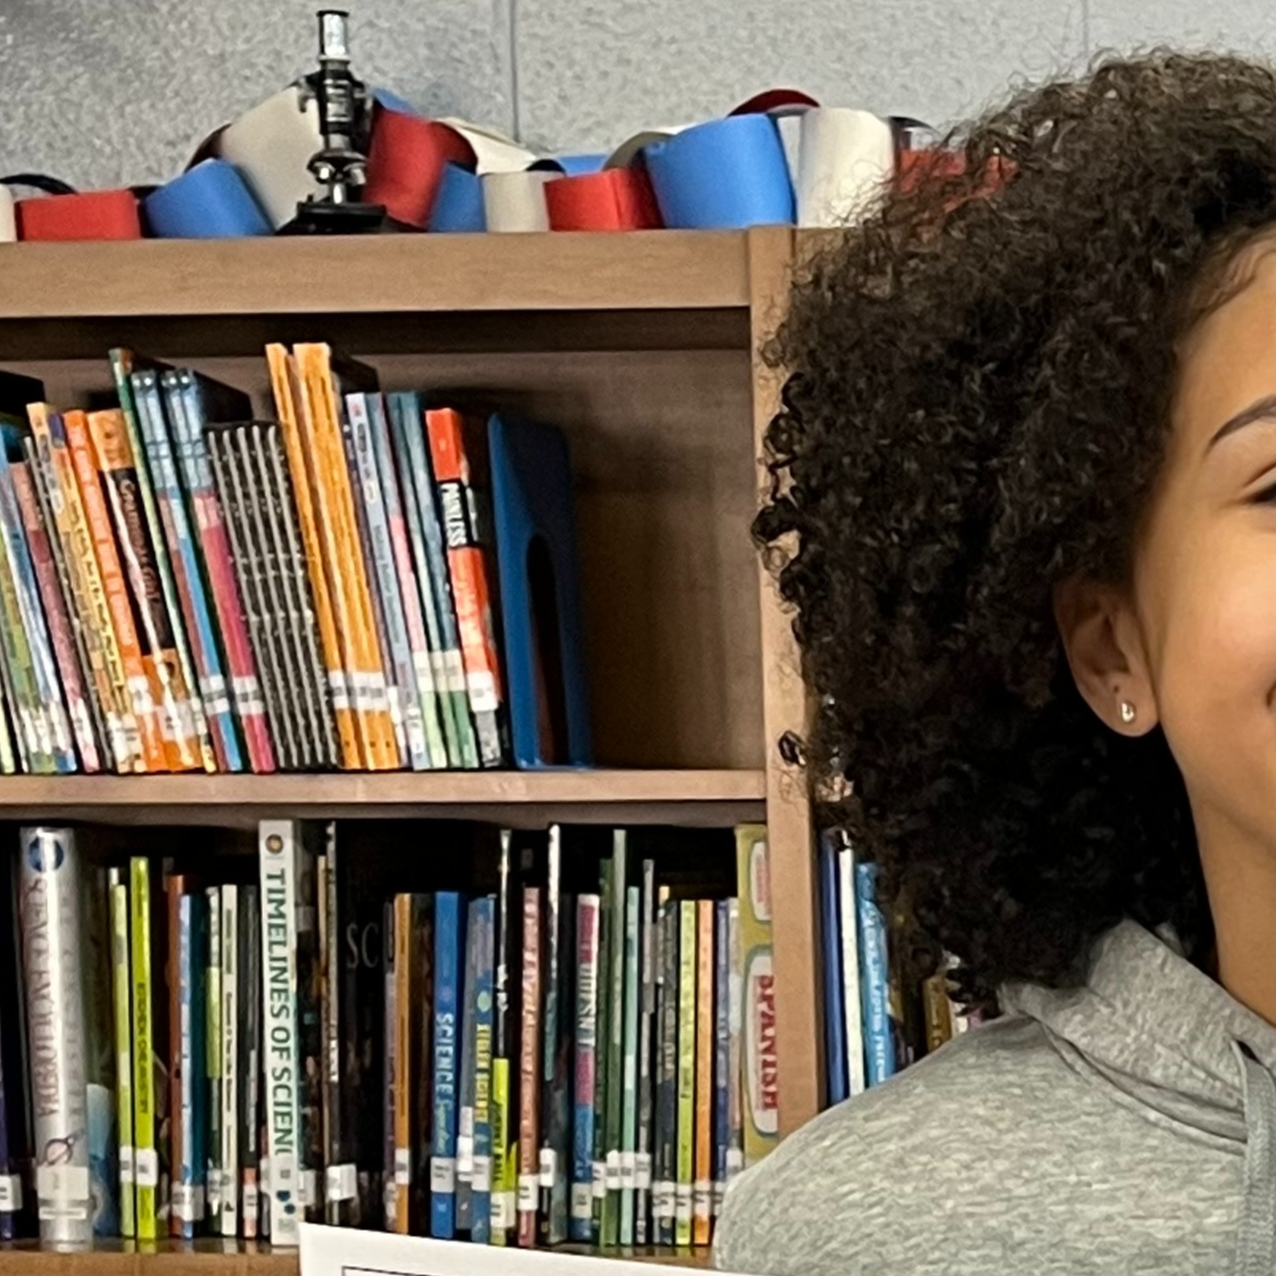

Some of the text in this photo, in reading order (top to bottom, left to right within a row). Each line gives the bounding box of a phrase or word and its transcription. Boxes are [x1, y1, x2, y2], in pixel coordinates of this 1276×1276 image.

[441, 482, 467, 548] PAINLESS
[266, 867, 290, 1019] TIMELINES
[270, 1026, 291, 1062] OF
[436, 1012, 454, 1093] SCIENCE
